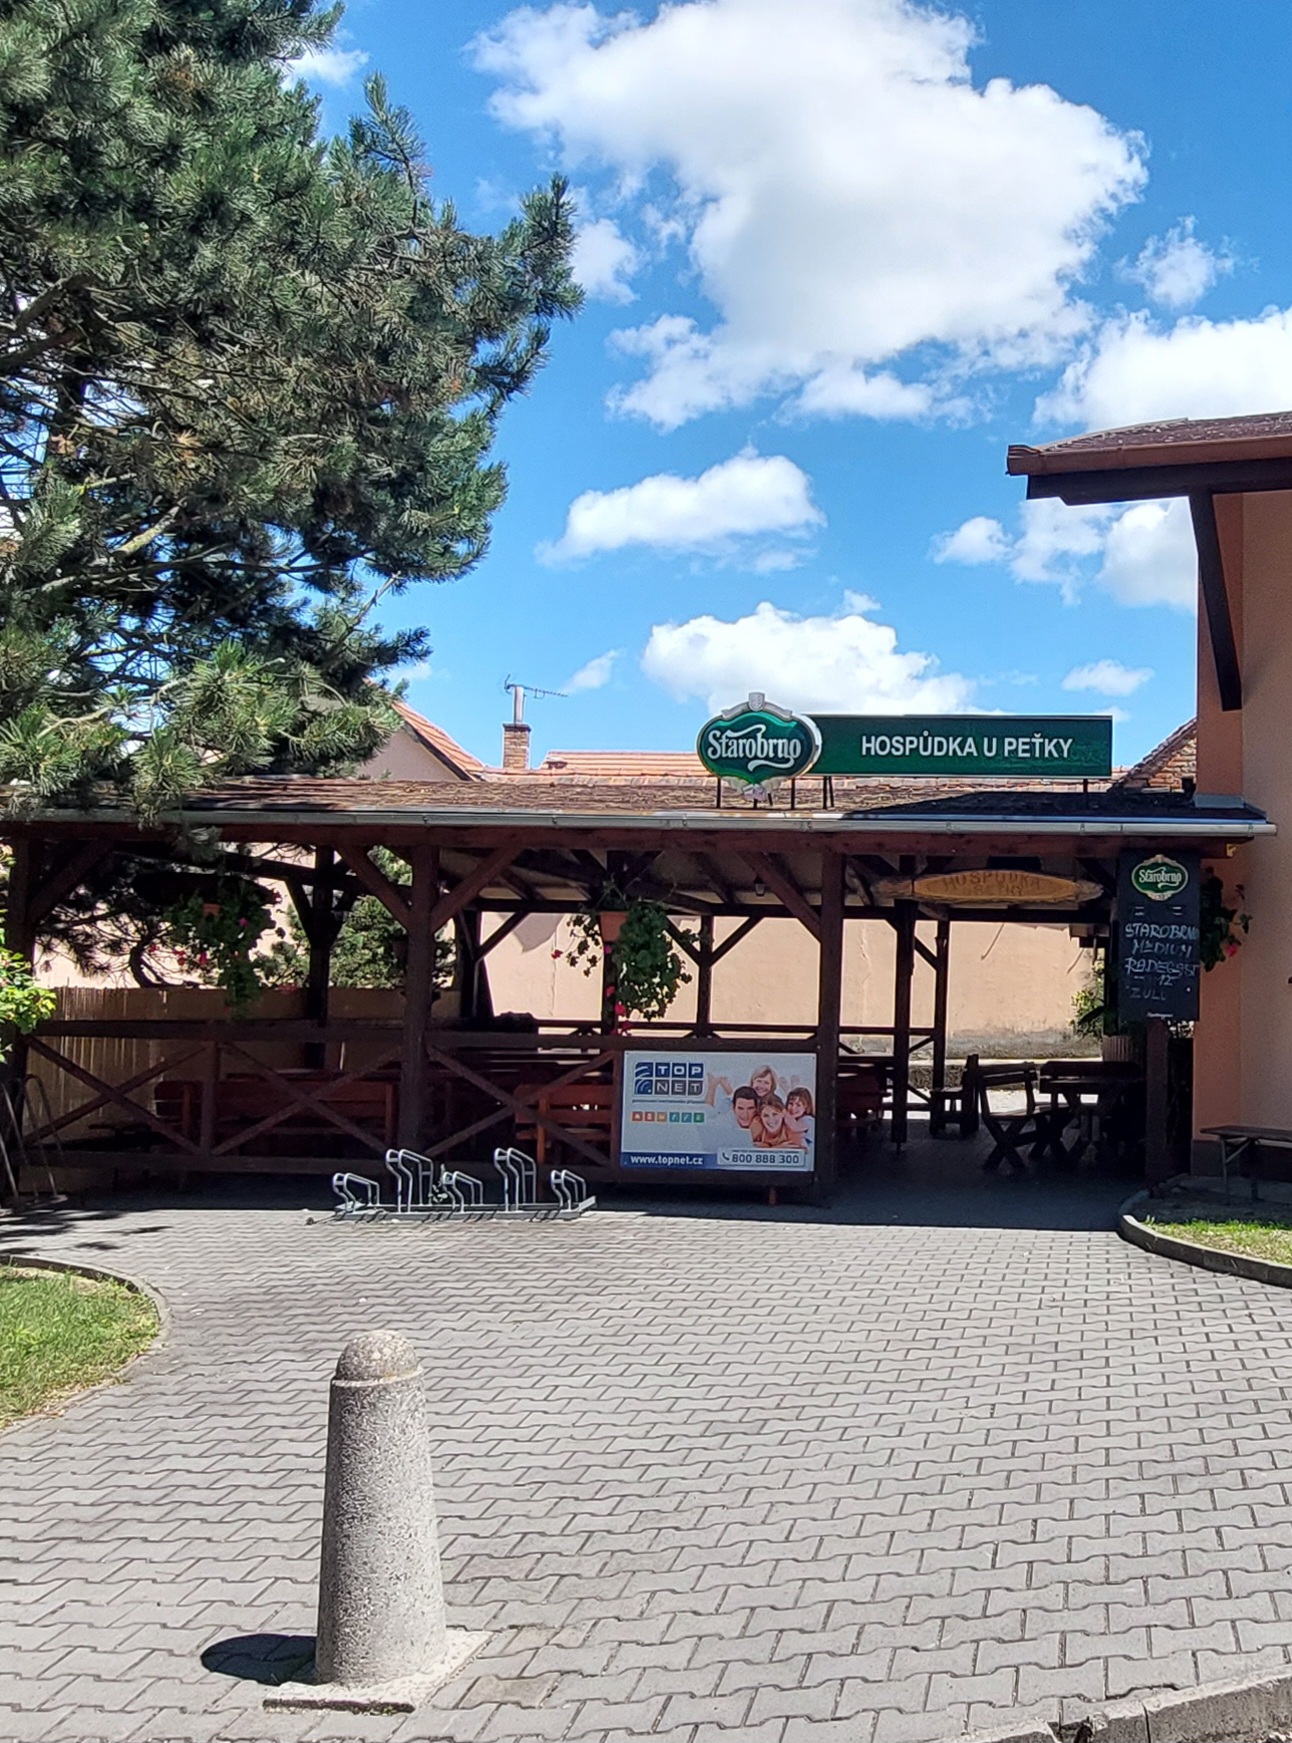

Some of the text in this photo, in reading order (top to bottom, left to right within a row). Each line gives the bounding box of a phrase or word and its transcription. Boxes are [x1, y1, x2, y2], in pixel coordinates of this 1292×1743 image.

[707, 723, 802, 772] Starobrno
[861, 730, 1073, 759] HOSPŮDKA U PEŤKY
[1138, 866, 1182, 889] Starobrno
[657, 1064, 702, 1076] TOP
[657, 1081, 701, 1093] NET
[630, 1154, 704, 1166] www.topnet.cz
[732, 1154, 799, 1164] 800 888 300
